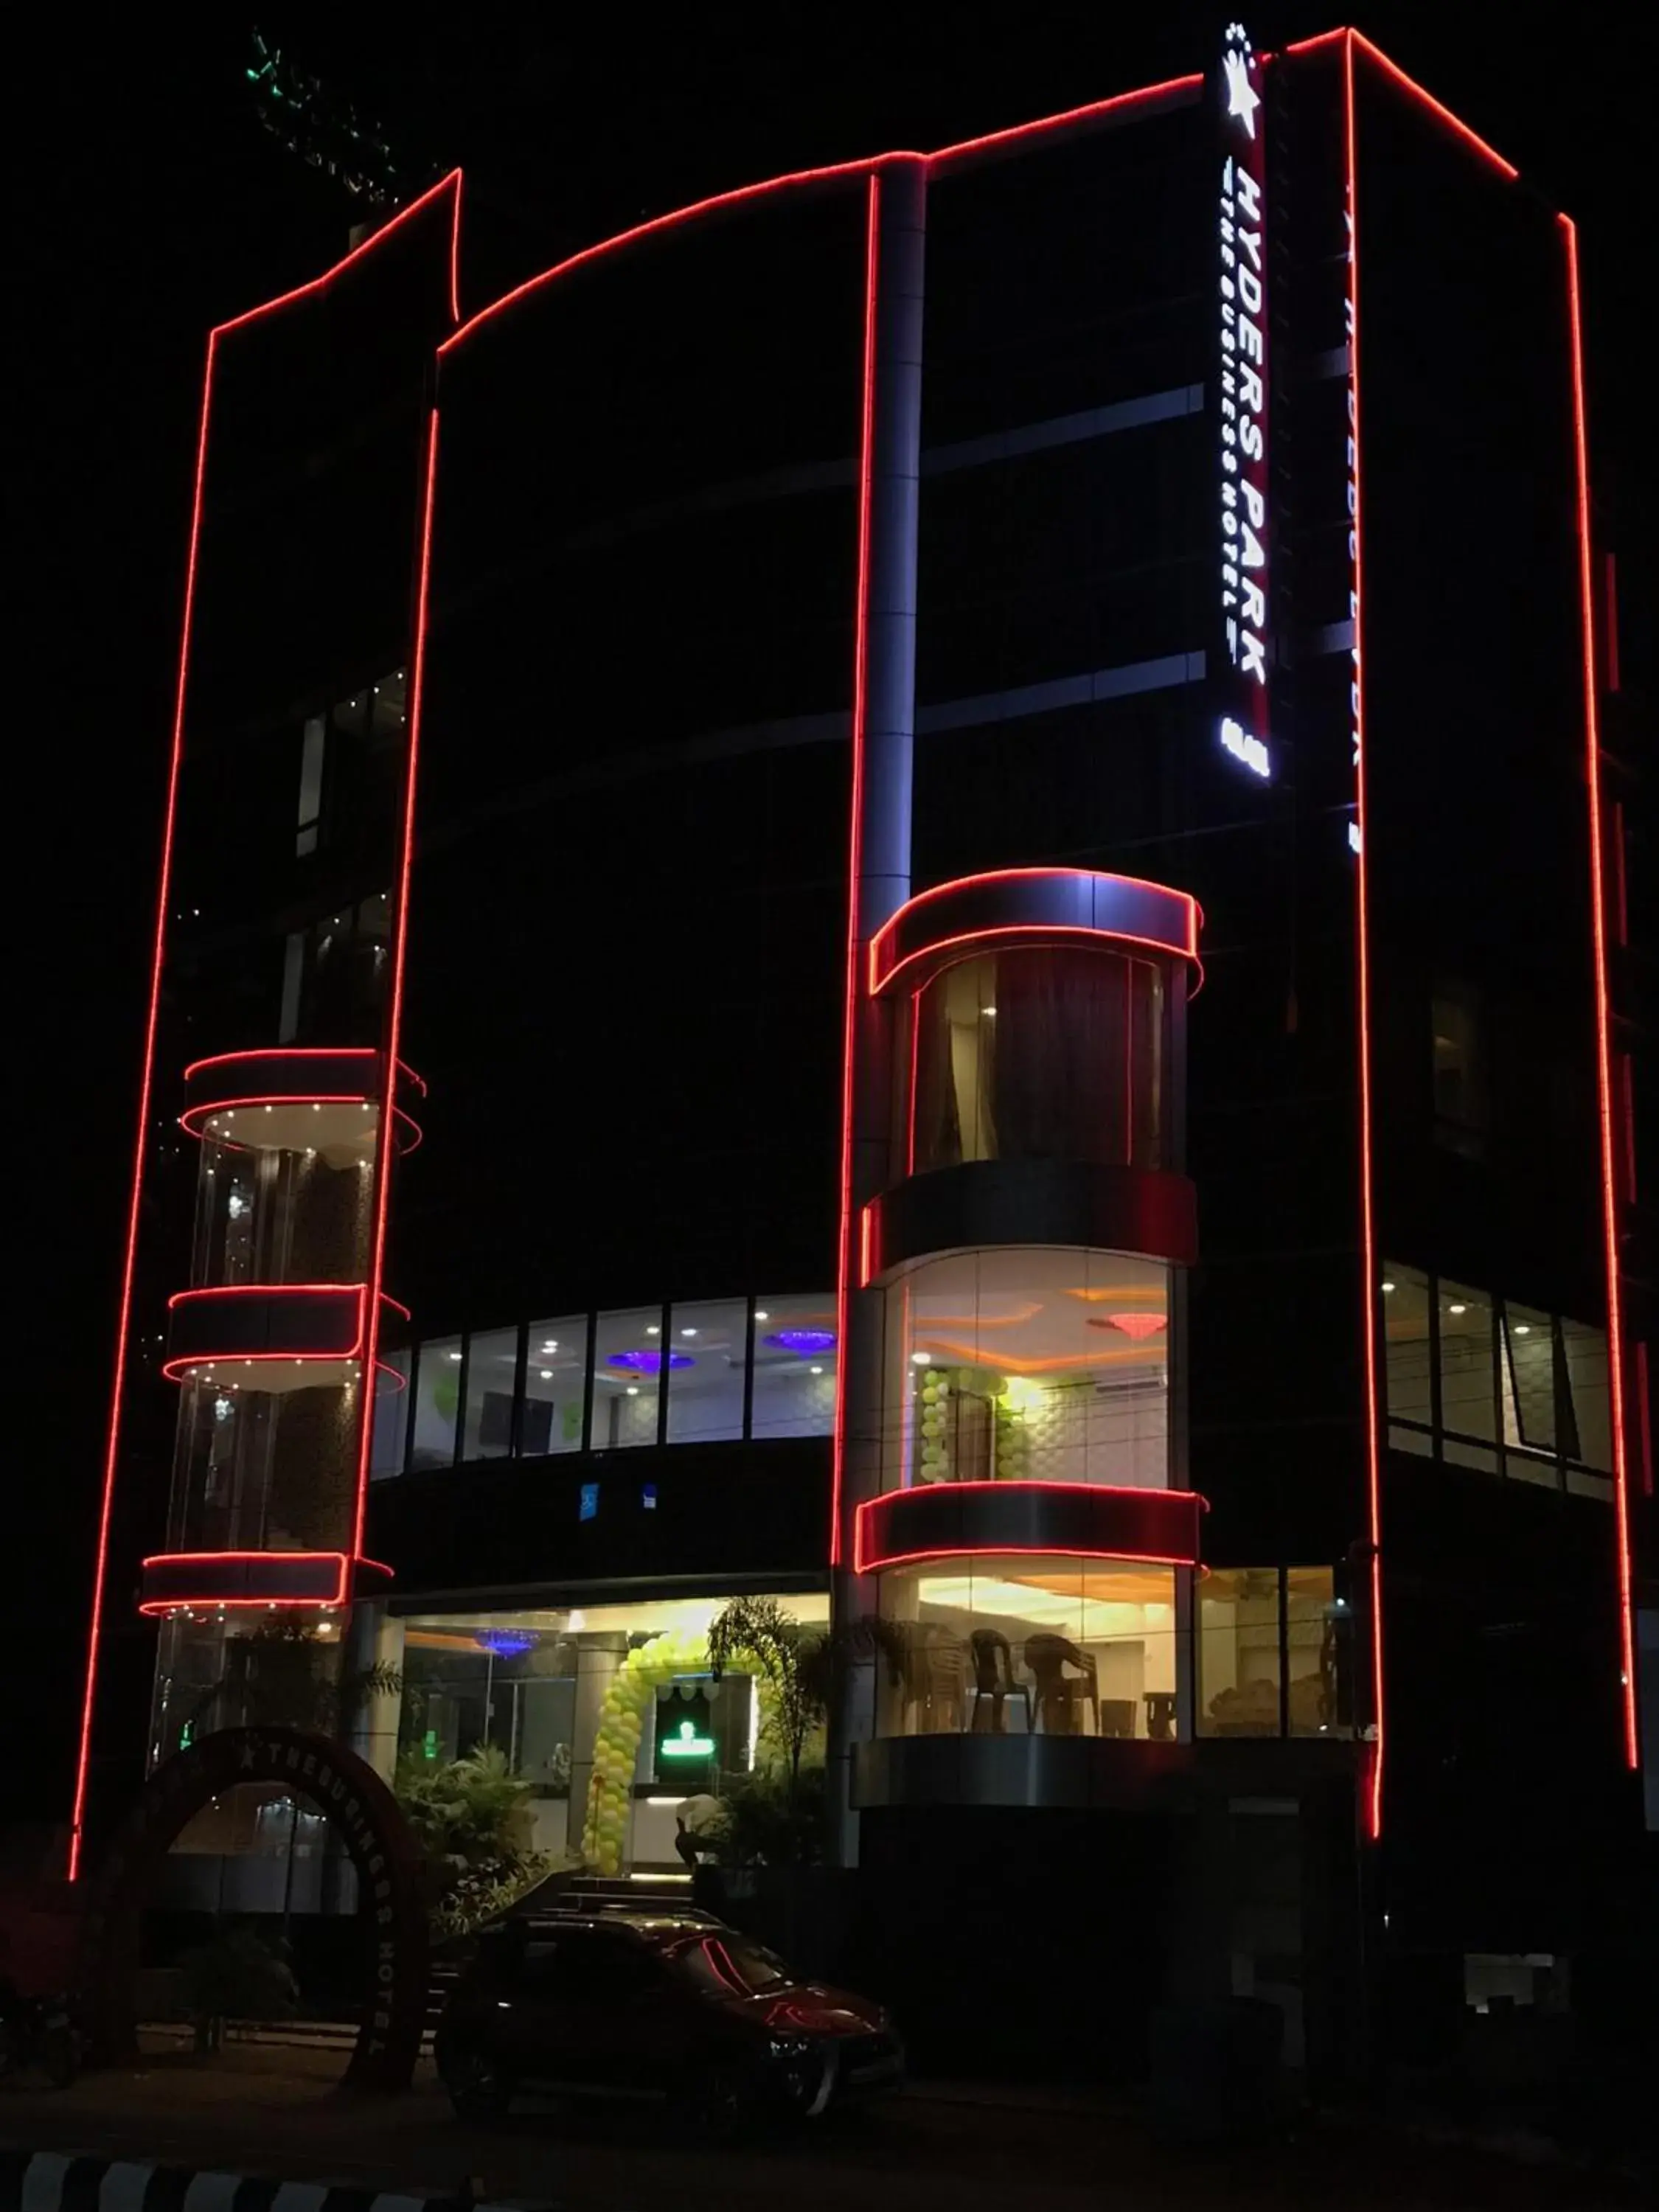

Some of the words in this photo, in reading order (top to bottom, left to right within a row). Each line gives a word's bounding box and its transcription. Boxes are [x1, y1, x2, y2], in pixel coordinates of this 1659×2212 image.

[1220, 196, 1236, 268] THE
[1237, 166, 1263, 462] HYDERS
[1220, 274, 1238, 473] BUSINESS
[1221, 481, 1238, 607] HOTEL
[1240, 478, 1265, 686] PARK
[267, 1742, 317, 1776] THE
[368, 1941, 396, 2056] HOTEL
